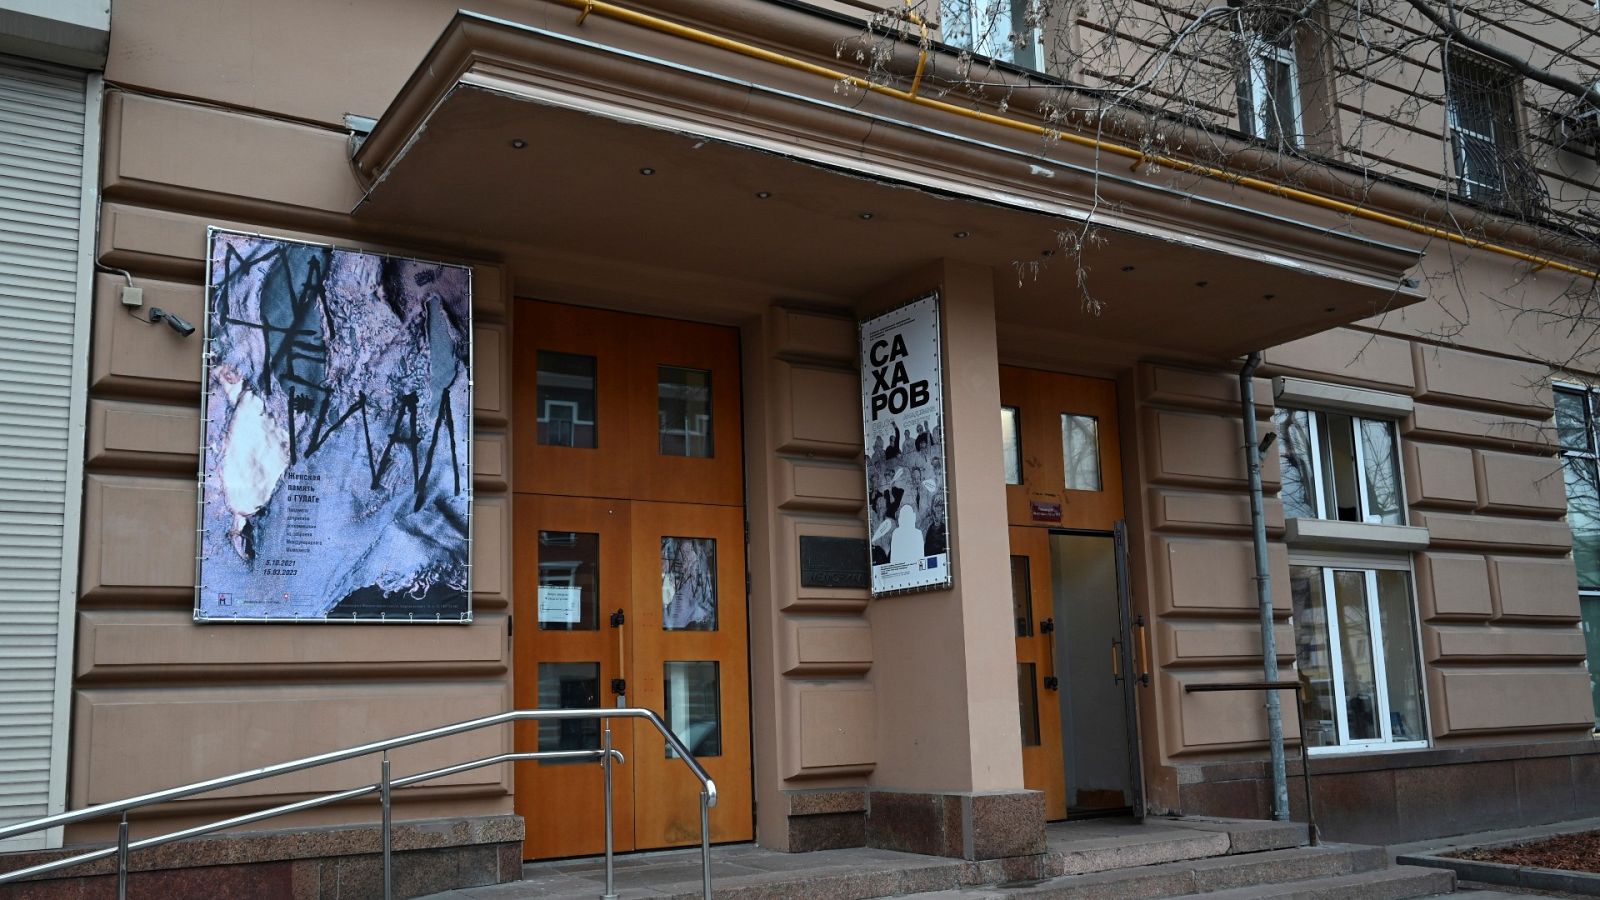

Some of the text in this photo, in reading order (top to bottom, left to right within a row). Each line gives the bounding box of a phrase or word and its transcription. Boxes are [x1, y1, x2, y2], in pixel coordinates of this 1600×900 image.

[870, 333, 909, 368] СА
[871, 360, 910, 396] ХА
[871, 379, 930, 421] РОВ
[287, 471, 321, 481] Женская
[287, 484, 315, 493] память
[294, 494, 320, 503] ГУЛАГе
